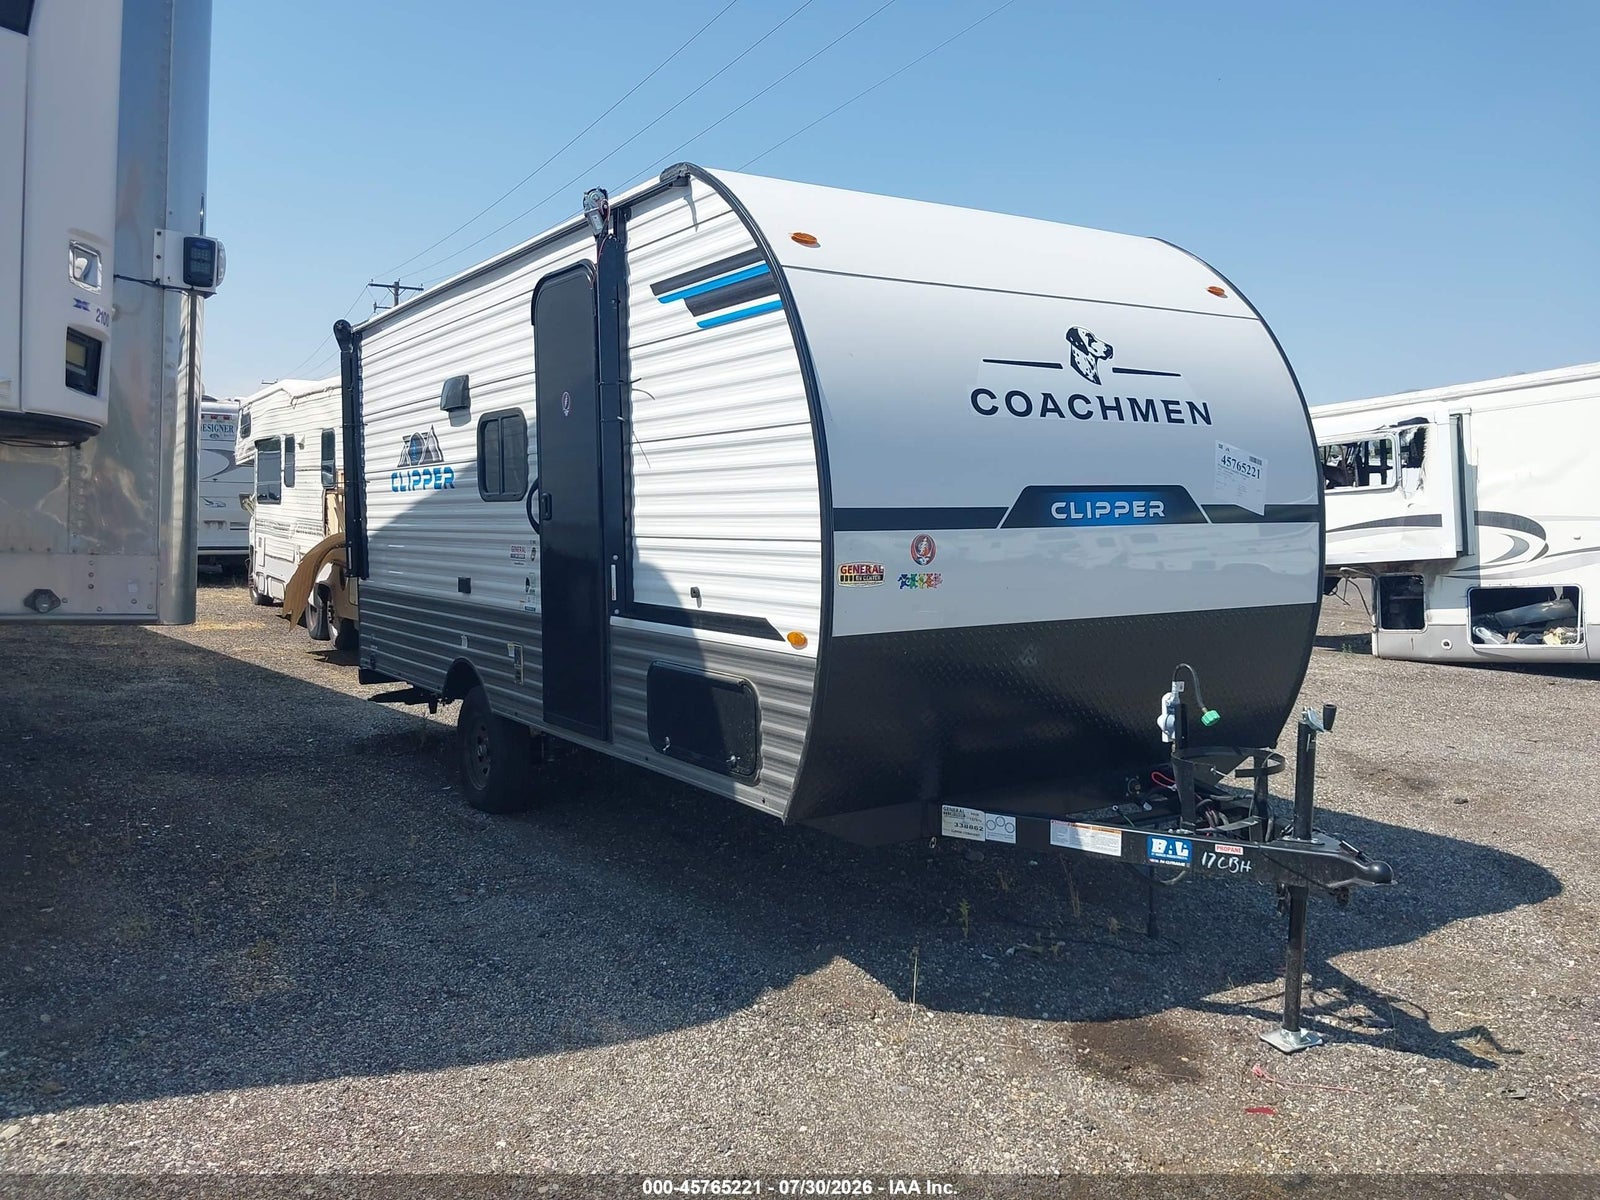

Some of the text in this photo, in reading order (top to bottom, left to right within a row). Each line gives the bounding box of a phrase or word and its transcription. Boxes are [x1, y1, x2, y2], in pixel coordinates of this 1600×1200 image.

[970, 388, 1213, 426] COACHMEN
[201, 423, 235, 434] ESIGNER
[1220, 455, 1261, 479] 45765221
[391, 466, 455, 492] CLIPPER
[1051, 500, 1166, 520] CLIPPER
[840, 564, 884, 575] GENERAL
[1151, 838, 1189, 857] BAL
[1216, 845, 1242, 854] PROPANE
